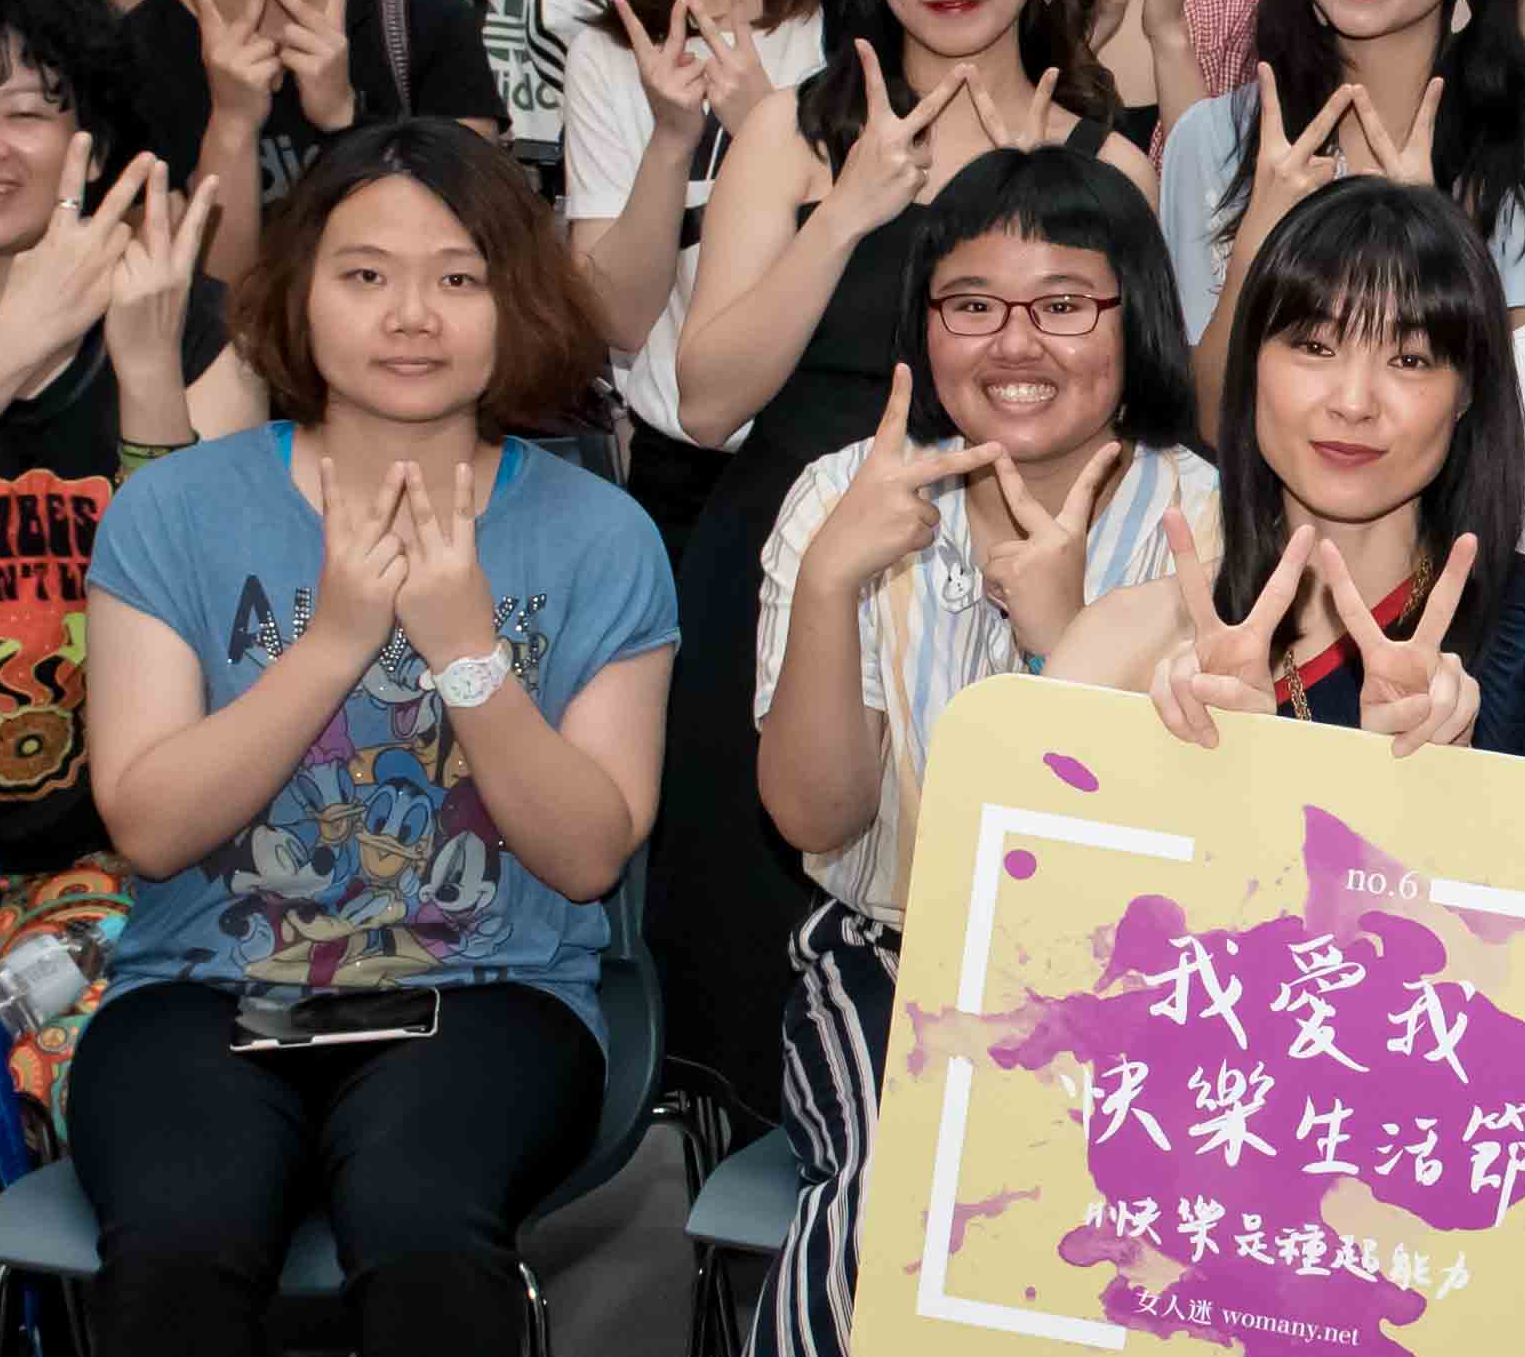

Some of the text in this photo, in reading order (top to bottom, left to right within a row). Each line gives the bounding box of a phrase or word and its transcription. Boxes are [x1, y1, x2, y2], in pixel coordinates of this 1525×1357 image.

[1345, 866, 1419, 901] no.6
[1144, 933, 1476, 1084] 我愛我
[1135, 1289, 1361, 1346] 女人迷 womany.net
